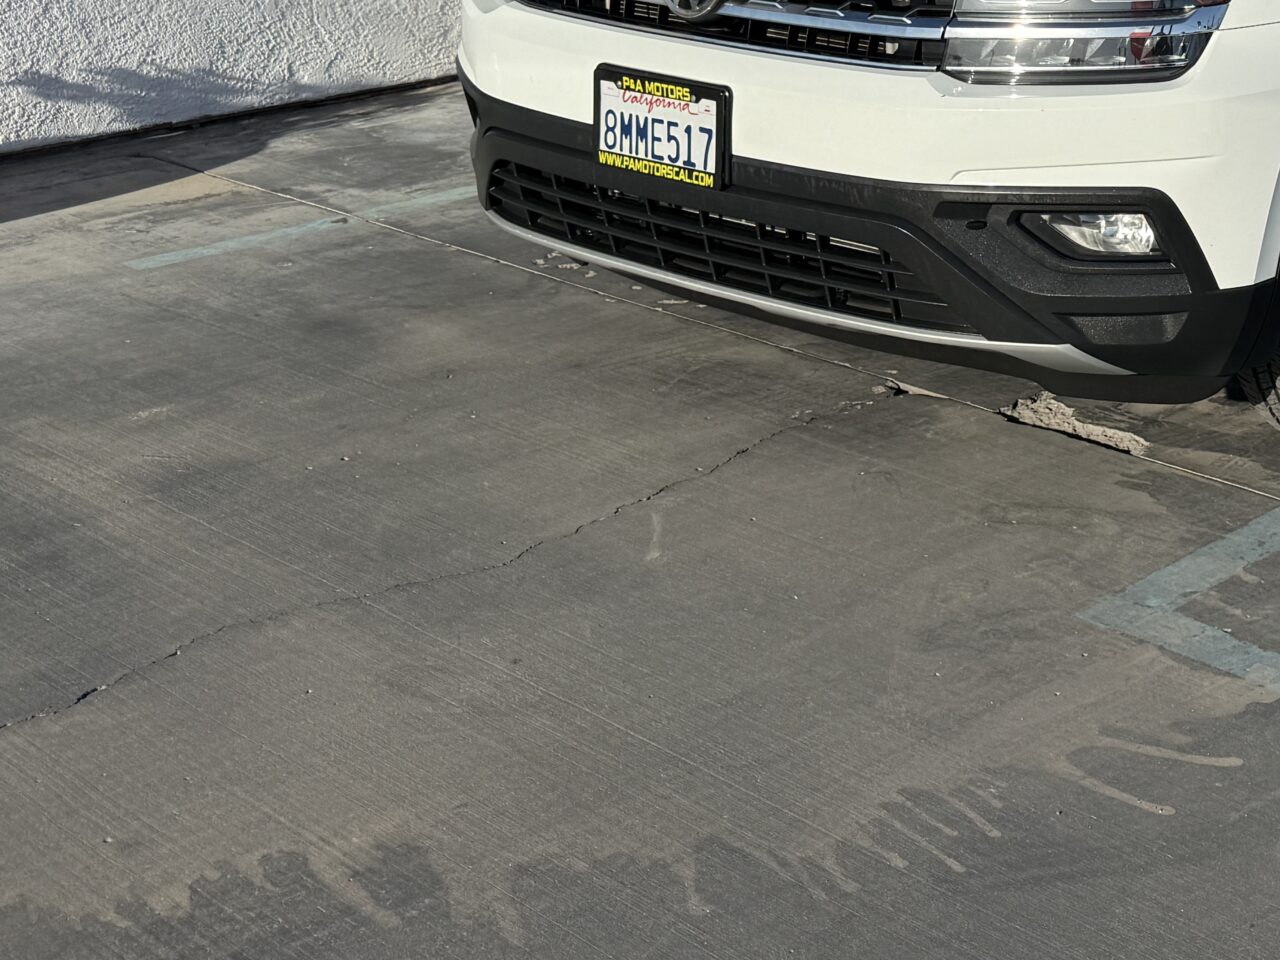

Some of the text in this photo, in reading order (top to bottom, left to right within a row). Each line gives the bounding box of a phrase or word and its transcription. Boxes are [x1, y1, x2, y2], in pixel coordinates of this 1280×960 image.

[622, 76, 691, 101] P&A MOTORS
[622, 90, 699, 115] California
[604, 109, 714, 171] 8MME517
[598, 150, 714, 188] WWW.PAMOTORSCAL.COM
